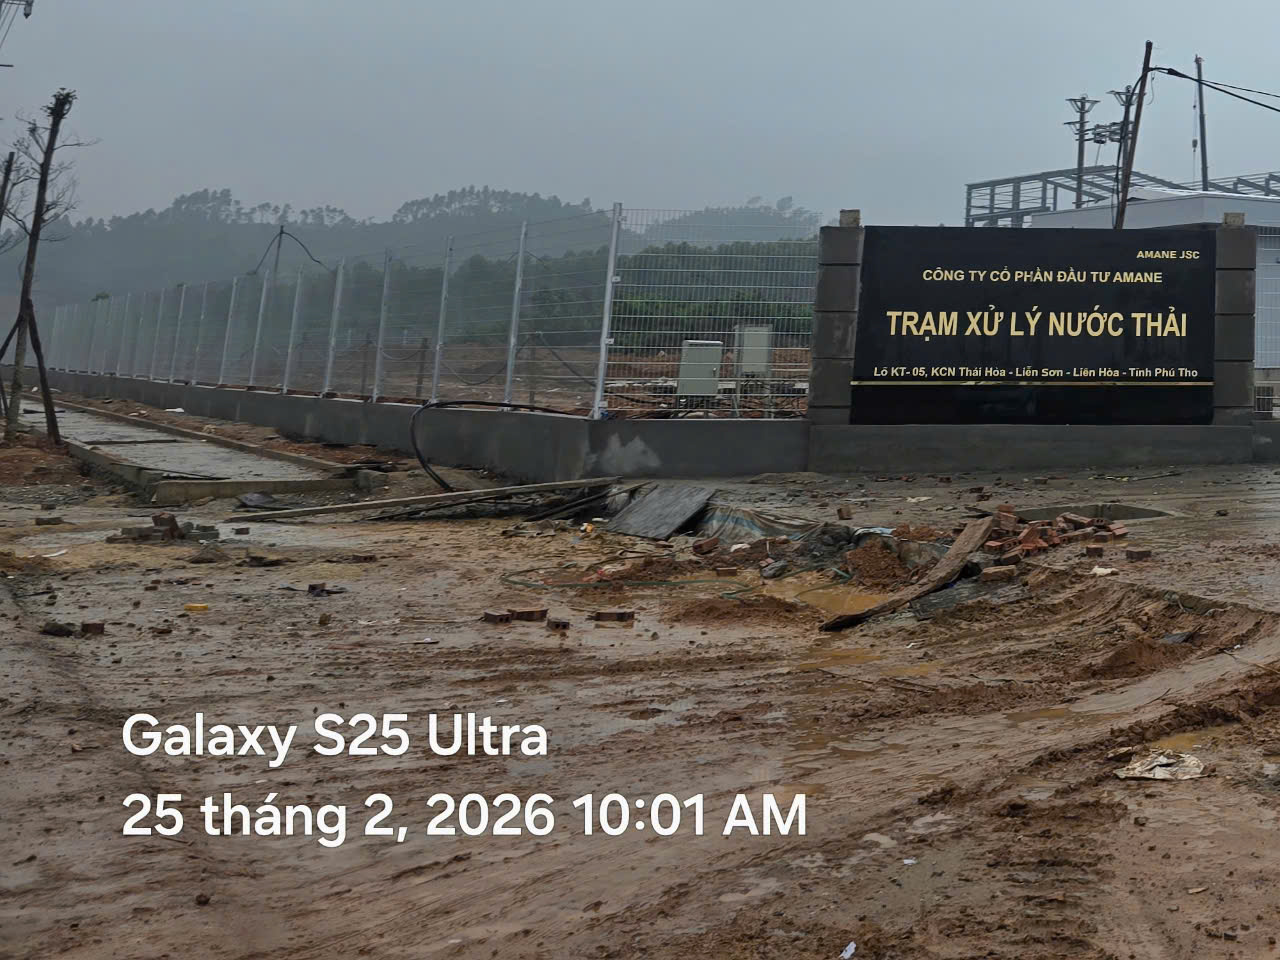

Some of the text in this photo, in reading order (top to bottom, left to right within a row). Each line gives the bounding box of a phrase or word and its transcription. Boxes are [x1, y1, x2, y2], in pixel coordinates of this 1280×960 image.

[1136, 250, 1177, 260] AMANE
[923, 266, 1163, 283] CÔNG TY CỔ PHẦN ĐẦU TƯ AMANE
[886, 305, 1187, 342] TRẠM XỬ LÝ NƯỚC THẢI
[931, 367, 956, 377] KCN
[959, 367, 982, 377] Thái
[1041, 367, 1063, 377] Sơn
[1155, 367, 1176, 377] Phú
